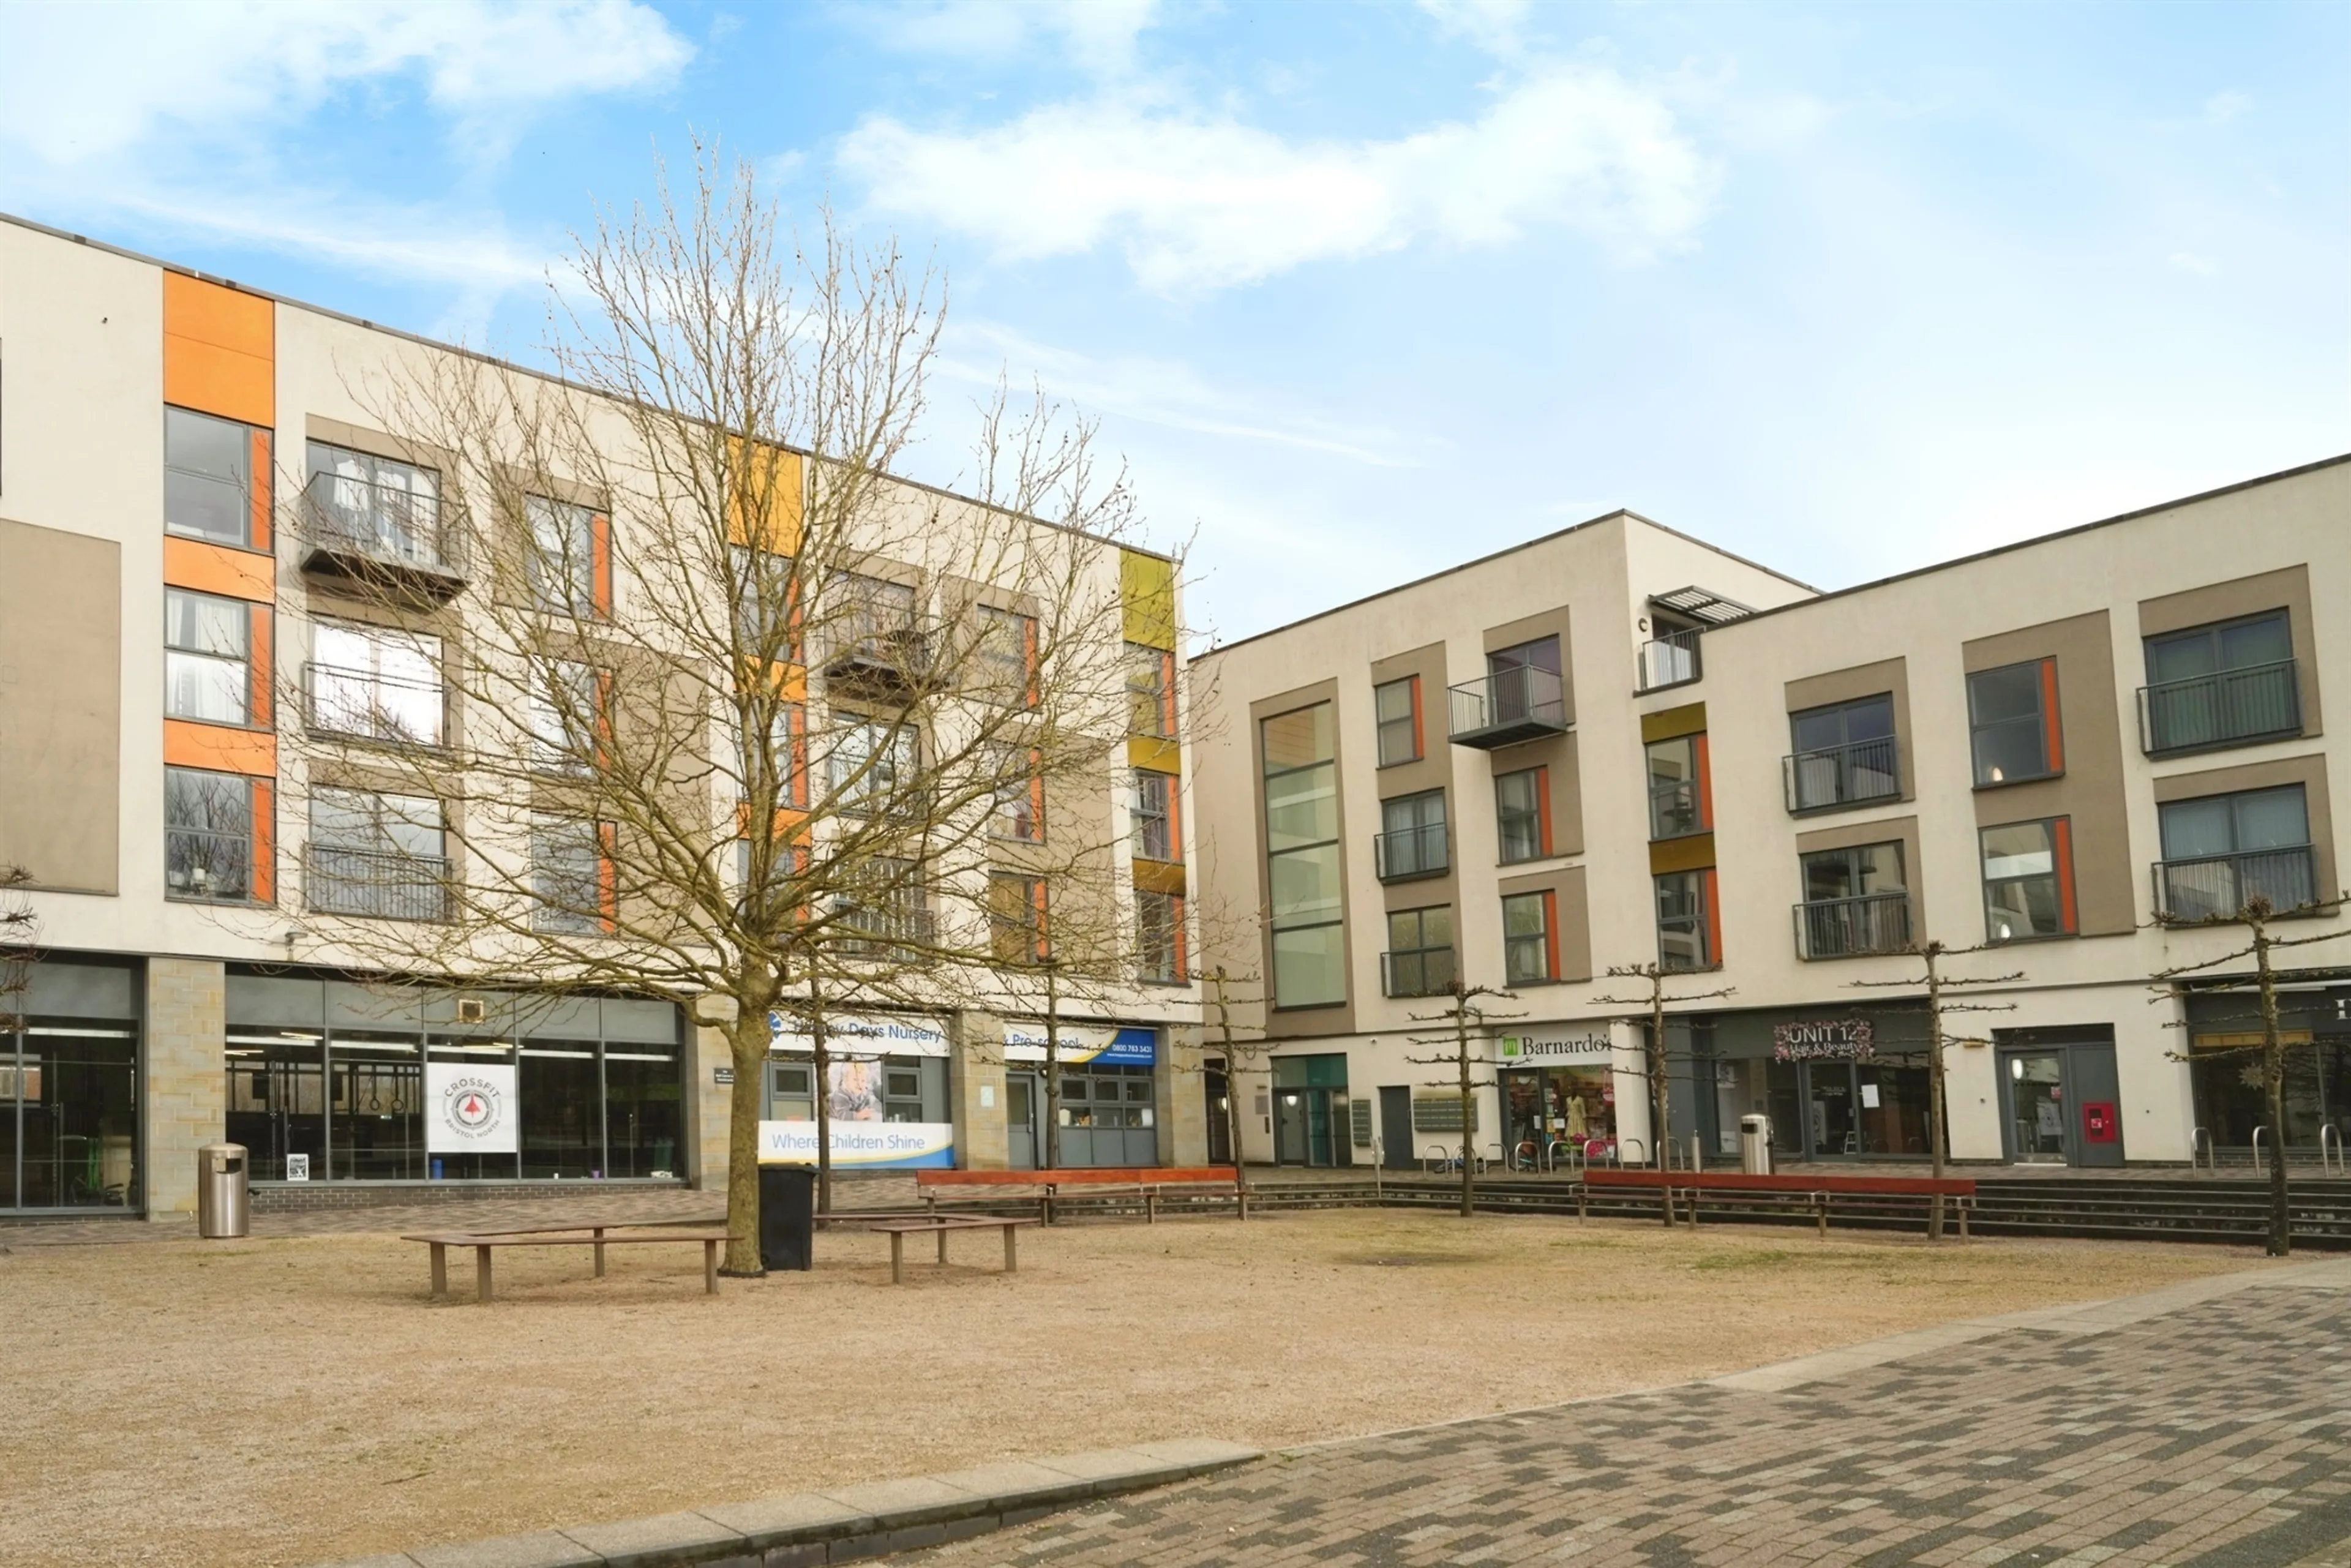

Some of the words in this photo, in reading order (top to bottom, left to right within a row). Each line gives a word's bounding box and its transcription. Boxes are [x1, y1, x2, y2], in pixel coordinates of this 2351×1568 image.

[889, 1025, 942, 1043] Nursery
[1790, 1026, 1833, 1043] UNIT
[1813, 1043, 1821, 1052] &
[445, 1078, 500, 1097] CROSSFIT
[444, 1118, 475, 1139] BRISTOL
[476, 1119, 500, 1138] NORTH
[771, 1134, 819, 1149] Where
[887, 1134, 926, 1149] Shine
